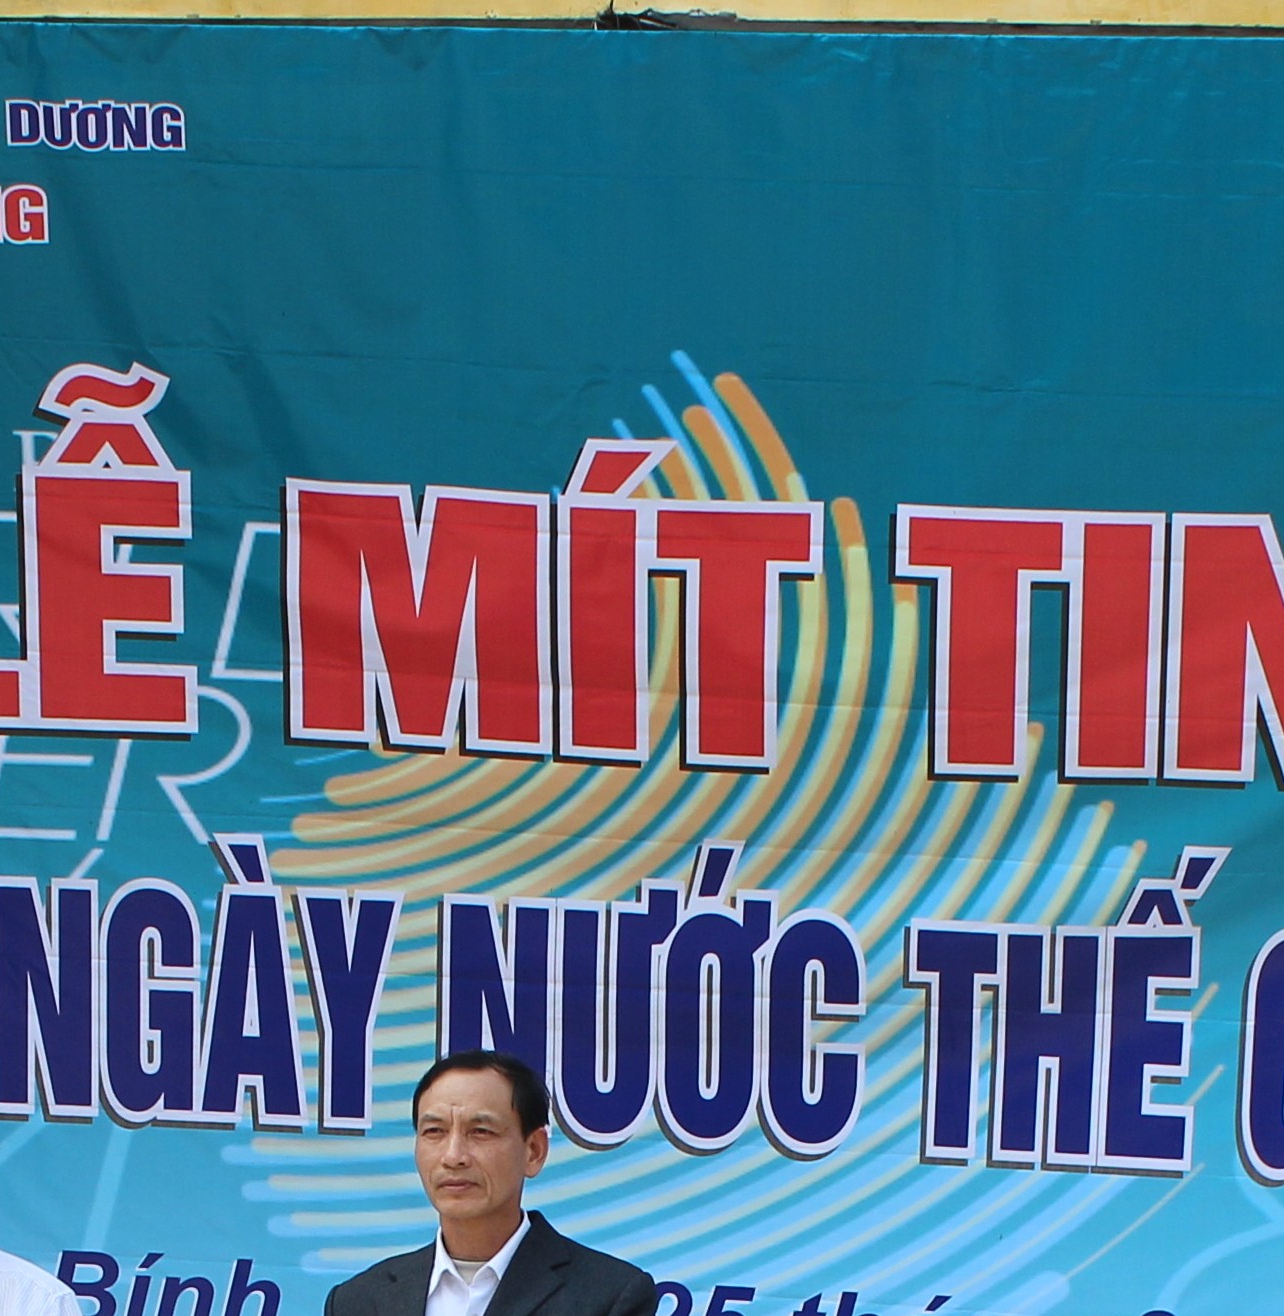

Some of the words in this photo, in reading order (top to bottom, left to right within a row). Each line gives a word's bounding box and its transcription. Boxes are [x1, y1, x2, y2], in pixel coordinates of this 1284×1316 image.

[6, 100, 186, 151] DƯƠNG
[282, 438, 825, 775] MÍT
[437, 839, 868, 1160] NƯỚC
[906, 846, 1232, 1173] THẾ
